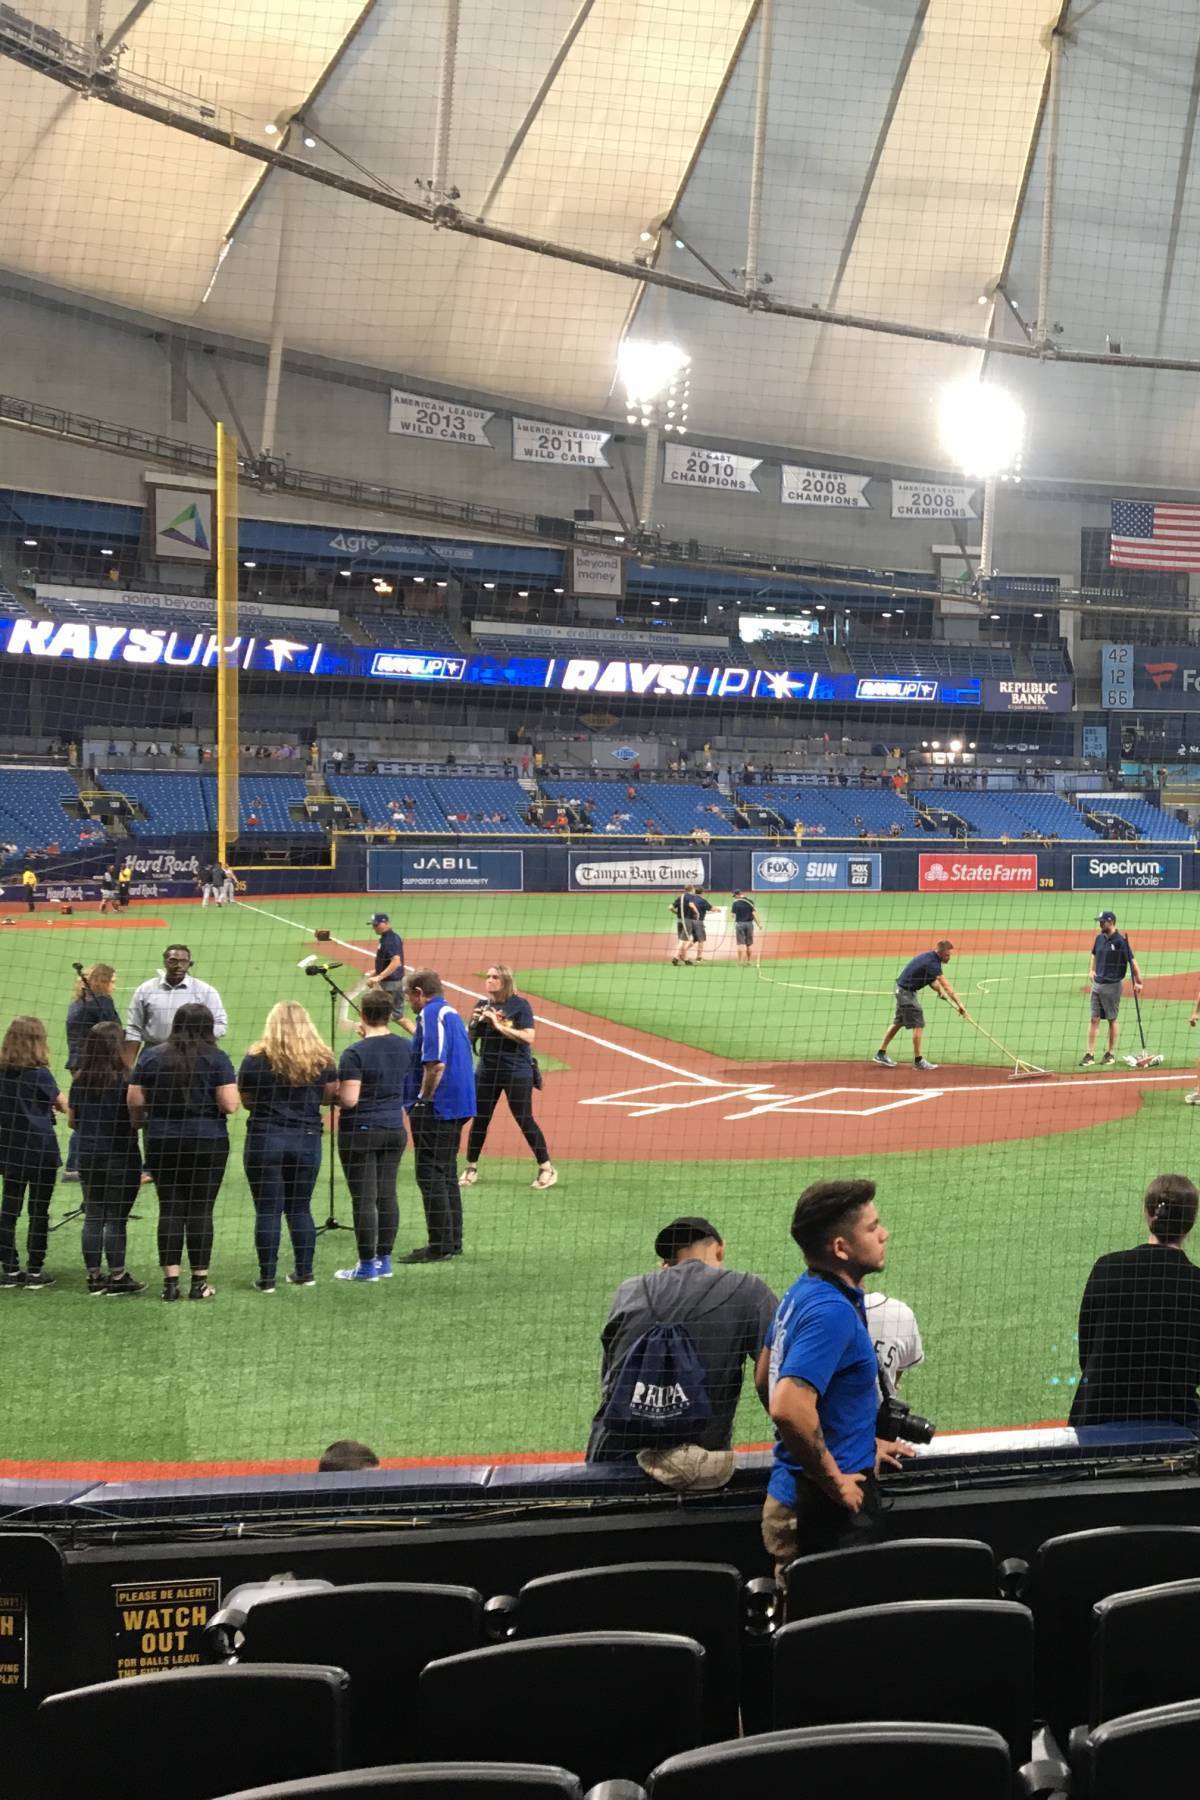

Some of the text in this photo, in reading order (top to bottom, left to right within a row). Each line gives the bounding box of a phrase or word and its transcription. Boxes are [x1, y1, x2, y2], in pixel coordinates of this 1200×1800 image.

[393, 395, 486, 420] AMERICAN LEAGUE
[415, 409, 467, 431] 2013
[400, 421, 477, 442] WILD CARD
[516, 424, 603, 442] AMERICAN LEAGUE
[537, 435, 584, 453] 2011
[523, 447, 596, 465] WILD CARD
[690, 450, 703, 460] AL
[686, 458, 735, 478] 2010
[805, 470, 818, 479] AL
[670, 471, 747, 490] CHAMPIONS
[801, 480, 848, 496] 2008
[787, 491, 859, 506] CHAMPIONS
[911, 493, 955, 508] 2008
[897, 505, 967, 518] CHAMPIONS
[348, 535, 379, 556] gte
[576, 556, 618, 569] beyond
[578, 571, 617, 583] money
[121, 593, 160, 608] going
[163, 595, 216, 612] beyond
[525, 627, 552, 637] auto
[1108, 649, 1129, 663] 42
[1111, 670, 1126, 685] 12
[999, 681, 1058, 695] REPUBLIC
[1011, 693, 1047, 705] BANK
[1108, 690, 1128, 705] 66
[124, 855, 200, 875] Hard Rock
[413, 858, 478, 869] JABIL
[767, 861, 789, 873] FOX
[806, 862, 838, 877] SUN
[851, 864, 869, 873] FOX
[1089, 859, 1160, 878] Spectrum
[581, 865, 699, 884] Tampa Bay Times
[851, 876, 868, 884] GO
[1126, 876, 1160, 886] mobile
[1039, 878, 1054, 888] 378
[119, 1587, 213, 1602] PLEASE BE ALERT!
[122, 1605, 207, 1631] WATCH
[141, 1631, 189, 1653] OUT
[118, 1657, 138, 1669] FOR
[139, 1655, 170, 1668] BALLS
